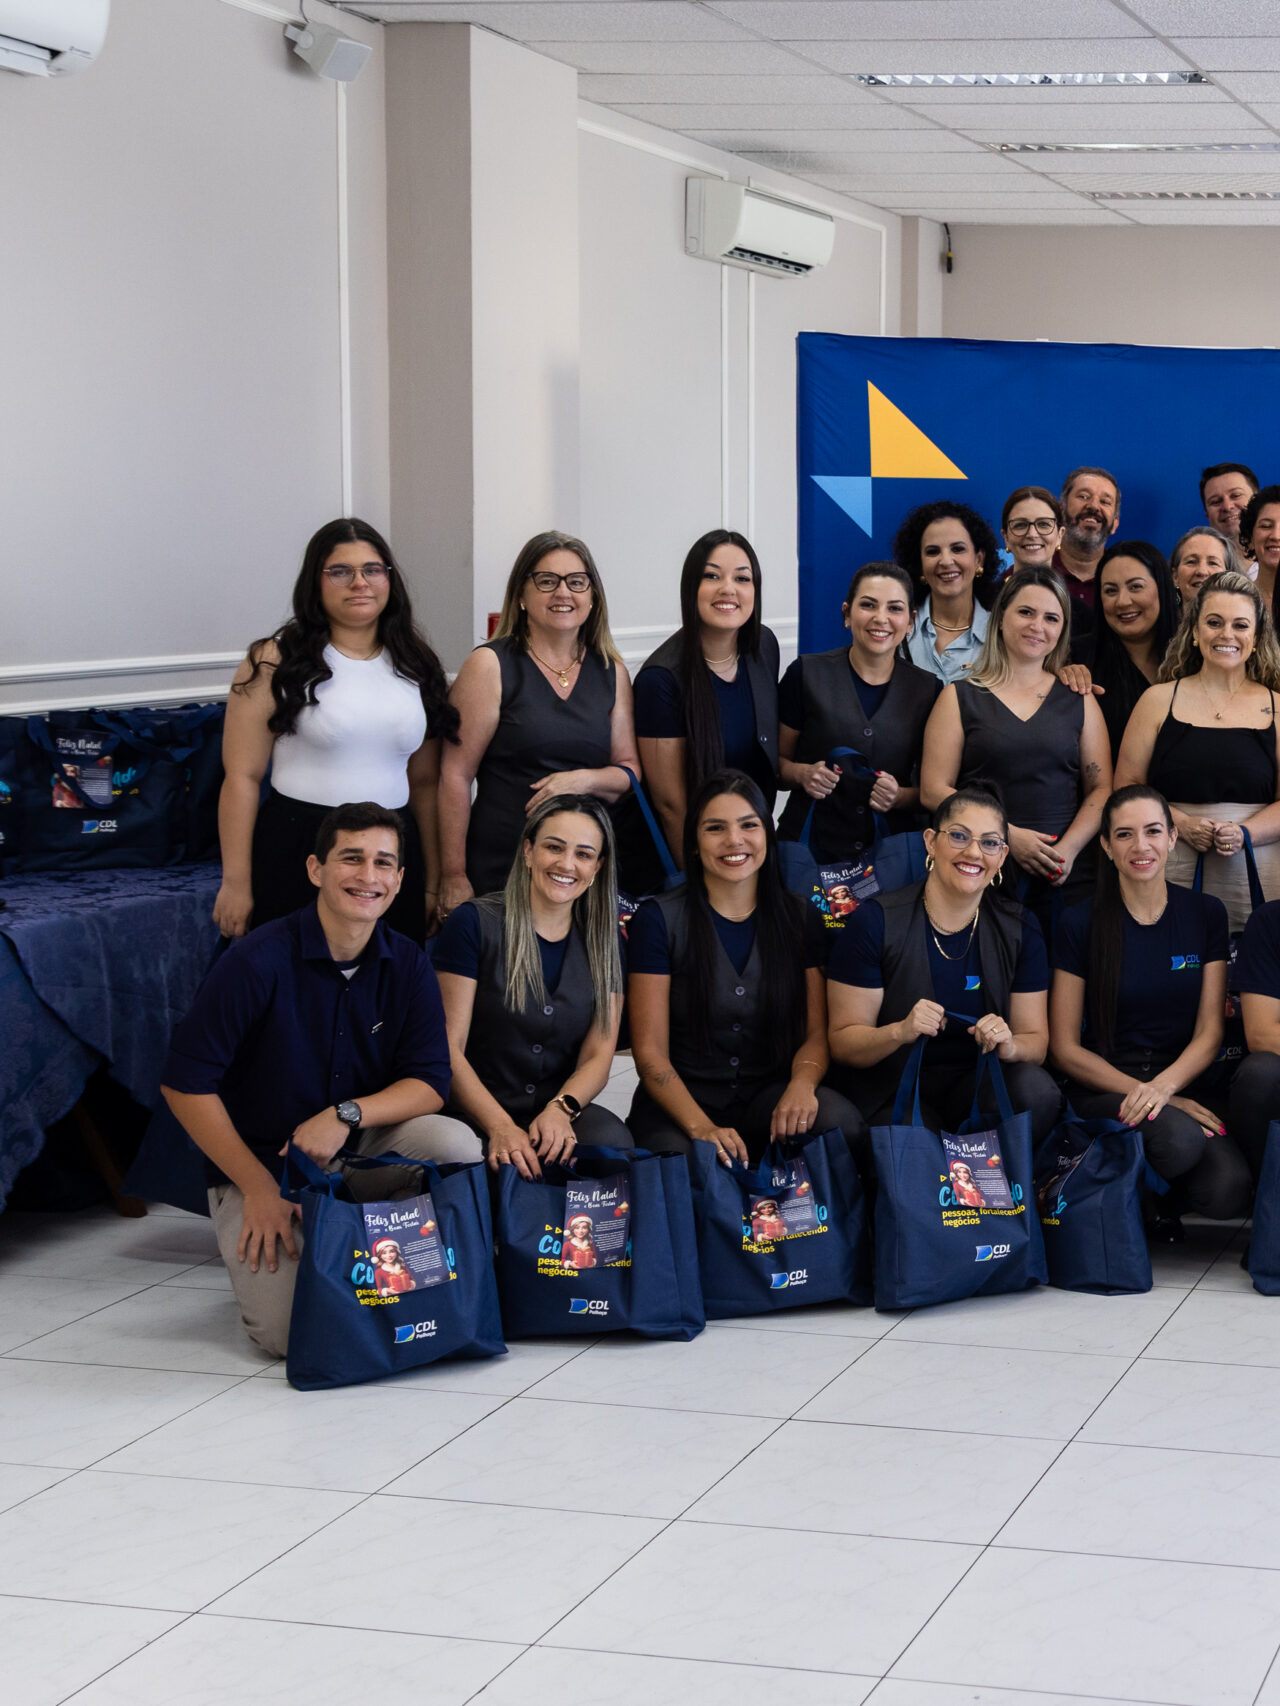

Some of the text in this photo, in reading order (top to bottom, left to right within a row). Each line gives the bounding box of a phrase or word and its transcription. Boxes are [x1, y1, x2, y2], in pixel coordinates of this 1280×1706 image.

[78, 739, 102, 750] Natal
[100, 820, 118, 828] CDL
[820, 863, 863, 880] Feliz Natal
[1186, 954, 1200, 964] CDL
[943, 1138, 987, 1152] Feliz Natal
[566, 1188, 618, 1203] Feliz Natal
[364, 1208, 420, 1228] Feliz Natal
[942, 1209, 978, 1219] pessoas,
[943, 1217, 980, 1228] negócios
[993, 1244, 1011, 1254] CDL
[538, 1266, 578, 1277] negócios
[790, 1268, 808, 1281] CDL
[360, 1296, 400, 1306] negócios
[588, 1300, 610, 1310] CDL
[415, 1320, 438, 1333] CDL
